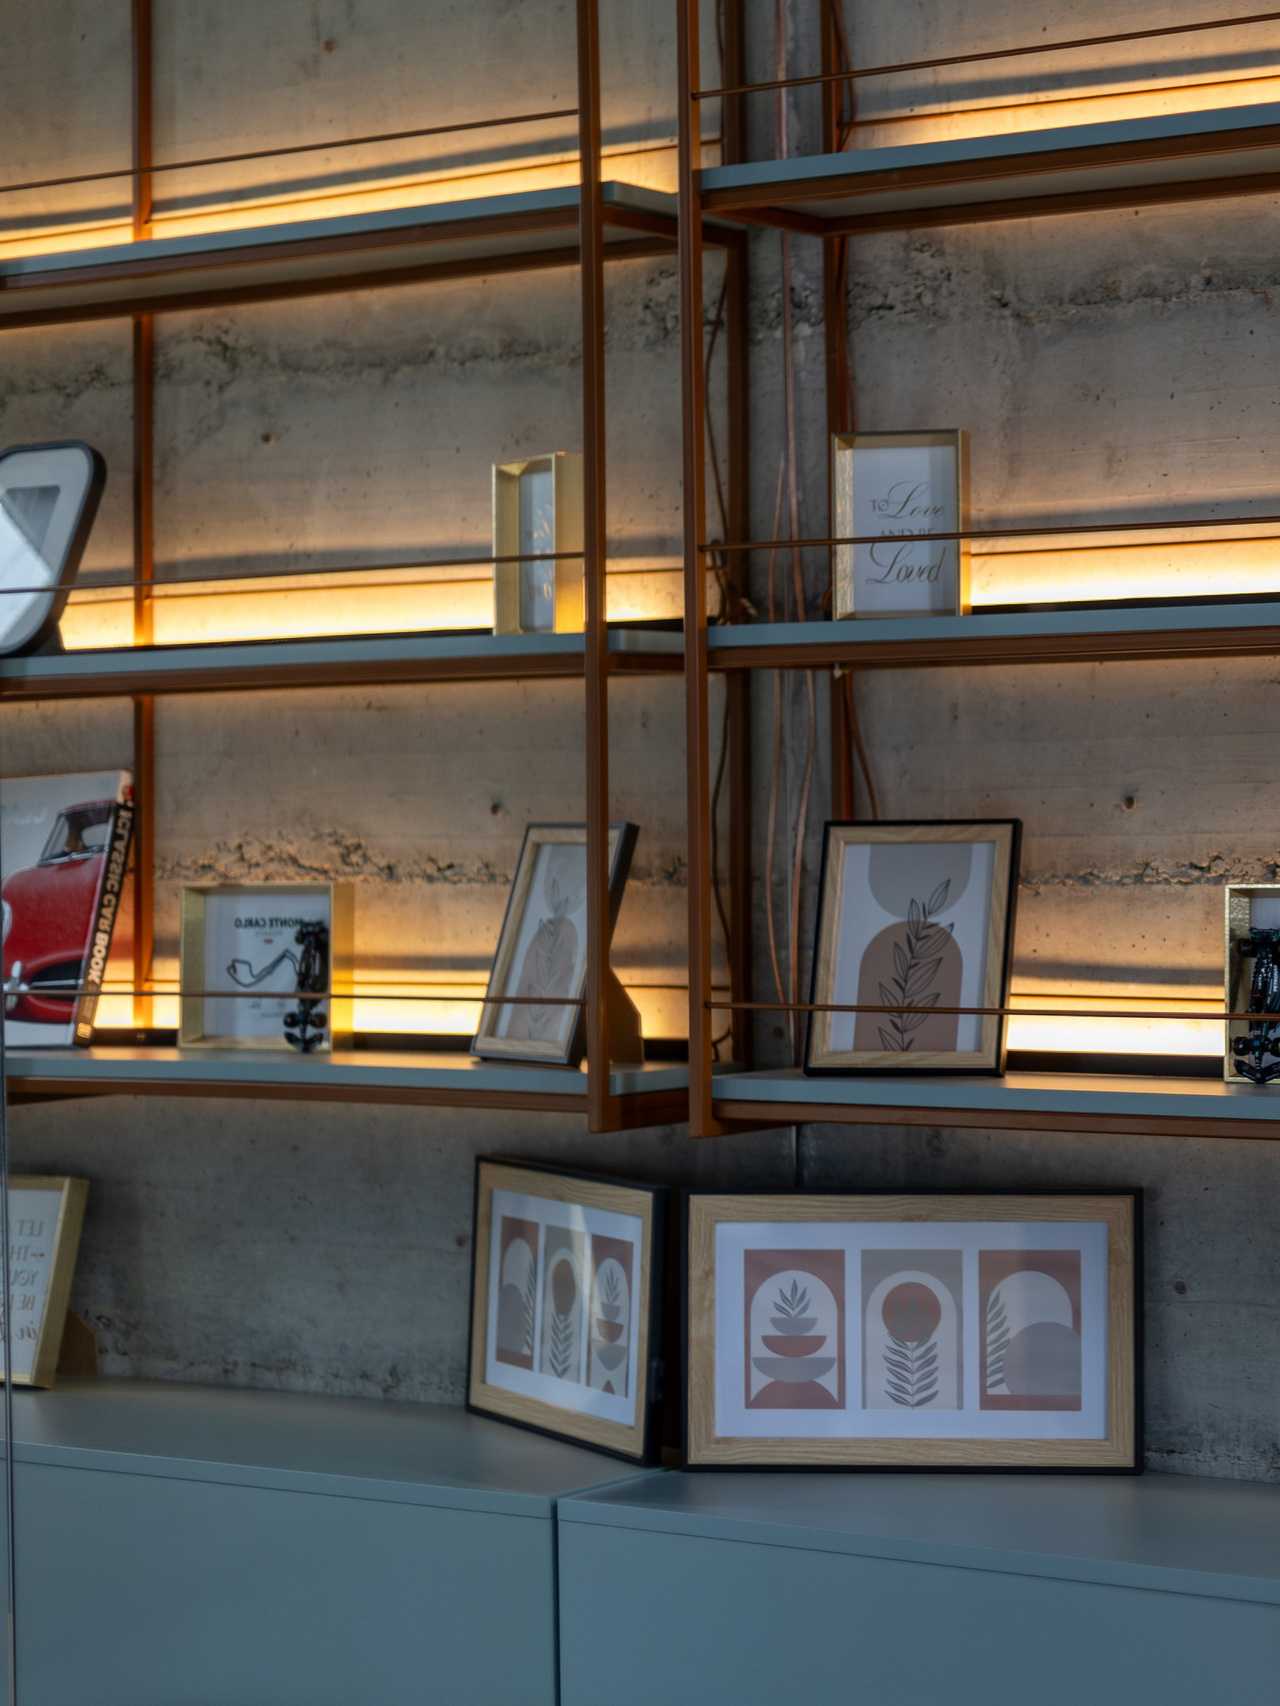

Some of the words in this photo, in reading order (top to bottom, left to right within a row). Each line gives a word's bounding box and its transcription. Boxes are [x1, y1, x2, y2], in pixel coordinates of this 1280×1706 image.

[870, 499, 889, 511] TO
[878, 481, 946, 520] Love
[865, 542, 947, 584] Loved
